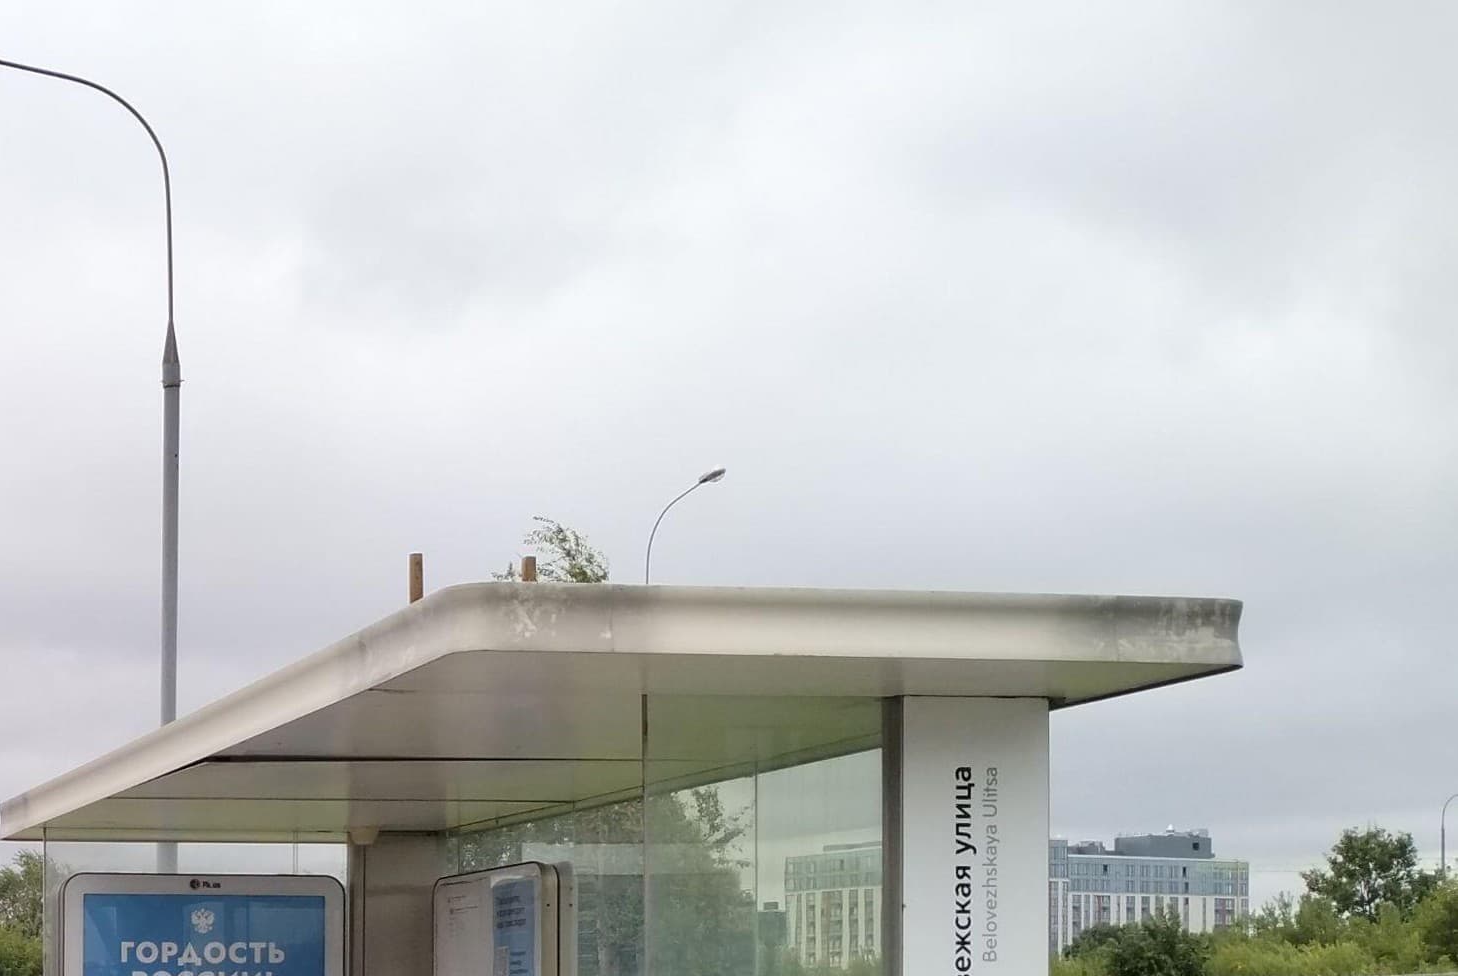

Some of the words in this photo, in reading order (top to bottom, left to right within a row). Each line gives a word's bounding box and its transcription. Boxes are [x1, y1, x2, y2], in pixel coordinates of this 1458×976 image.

[955, 766, 977, 855] улица
[982, 767, 998, 817] Ulitsa
[982, 825, 999, 962] Belovezhskaya
[120, 941, 285, 966] ГОРДОСТЬ
